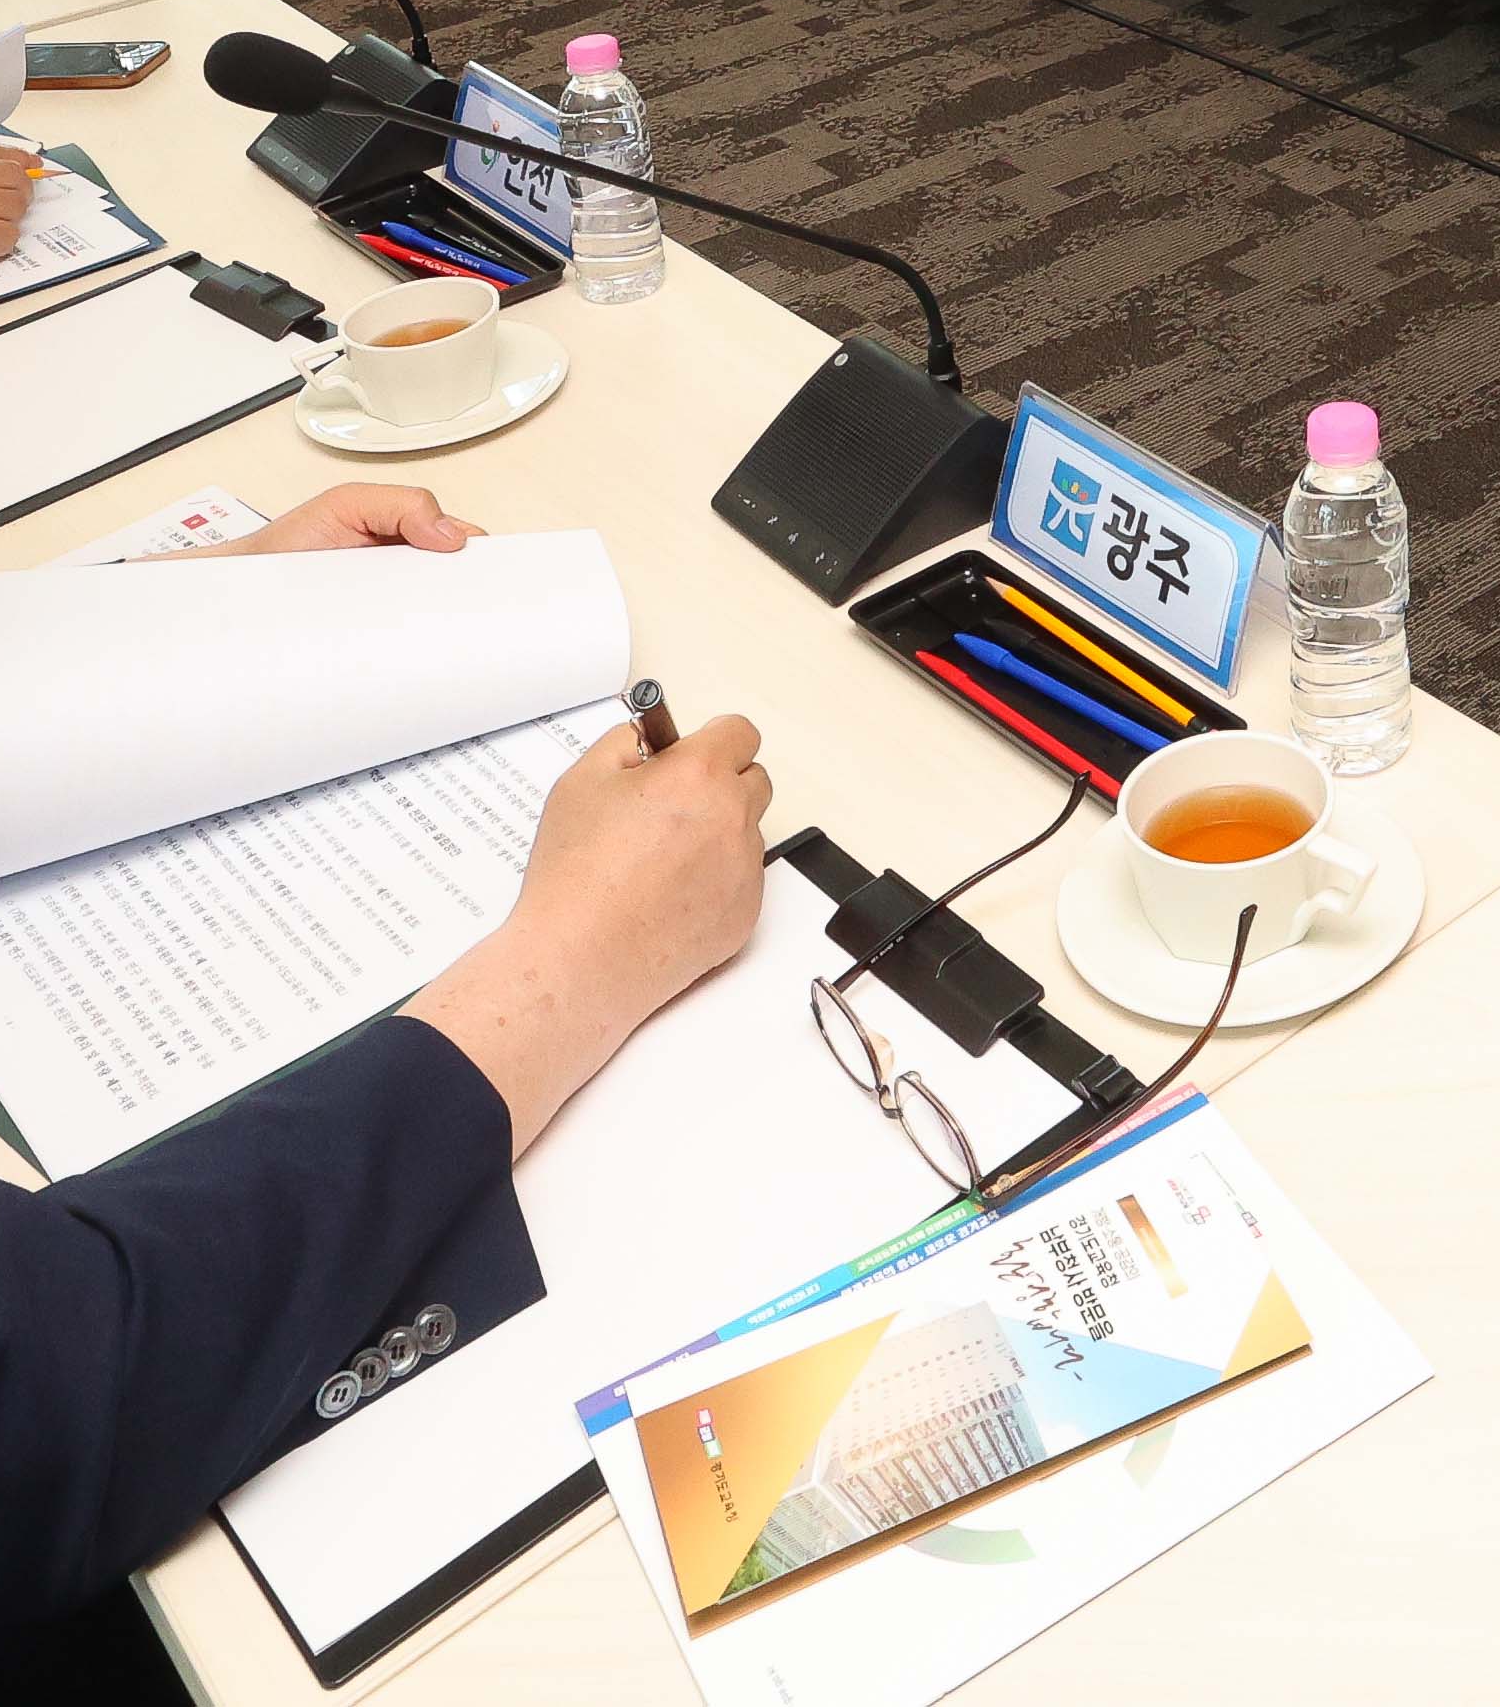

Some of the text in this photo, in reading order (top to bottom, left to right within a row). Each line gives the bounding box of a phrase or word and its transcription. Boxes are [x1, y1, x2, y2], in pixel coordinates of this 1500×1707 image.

[1100, 492, 1192, 606] 광주
[1037, 1223, 1117, 1344] 남부청사 방문을
[1066, 1212, 1121, 1291] 경기도교육청
[708, 1459, 739, 1524] 경기도교육청
